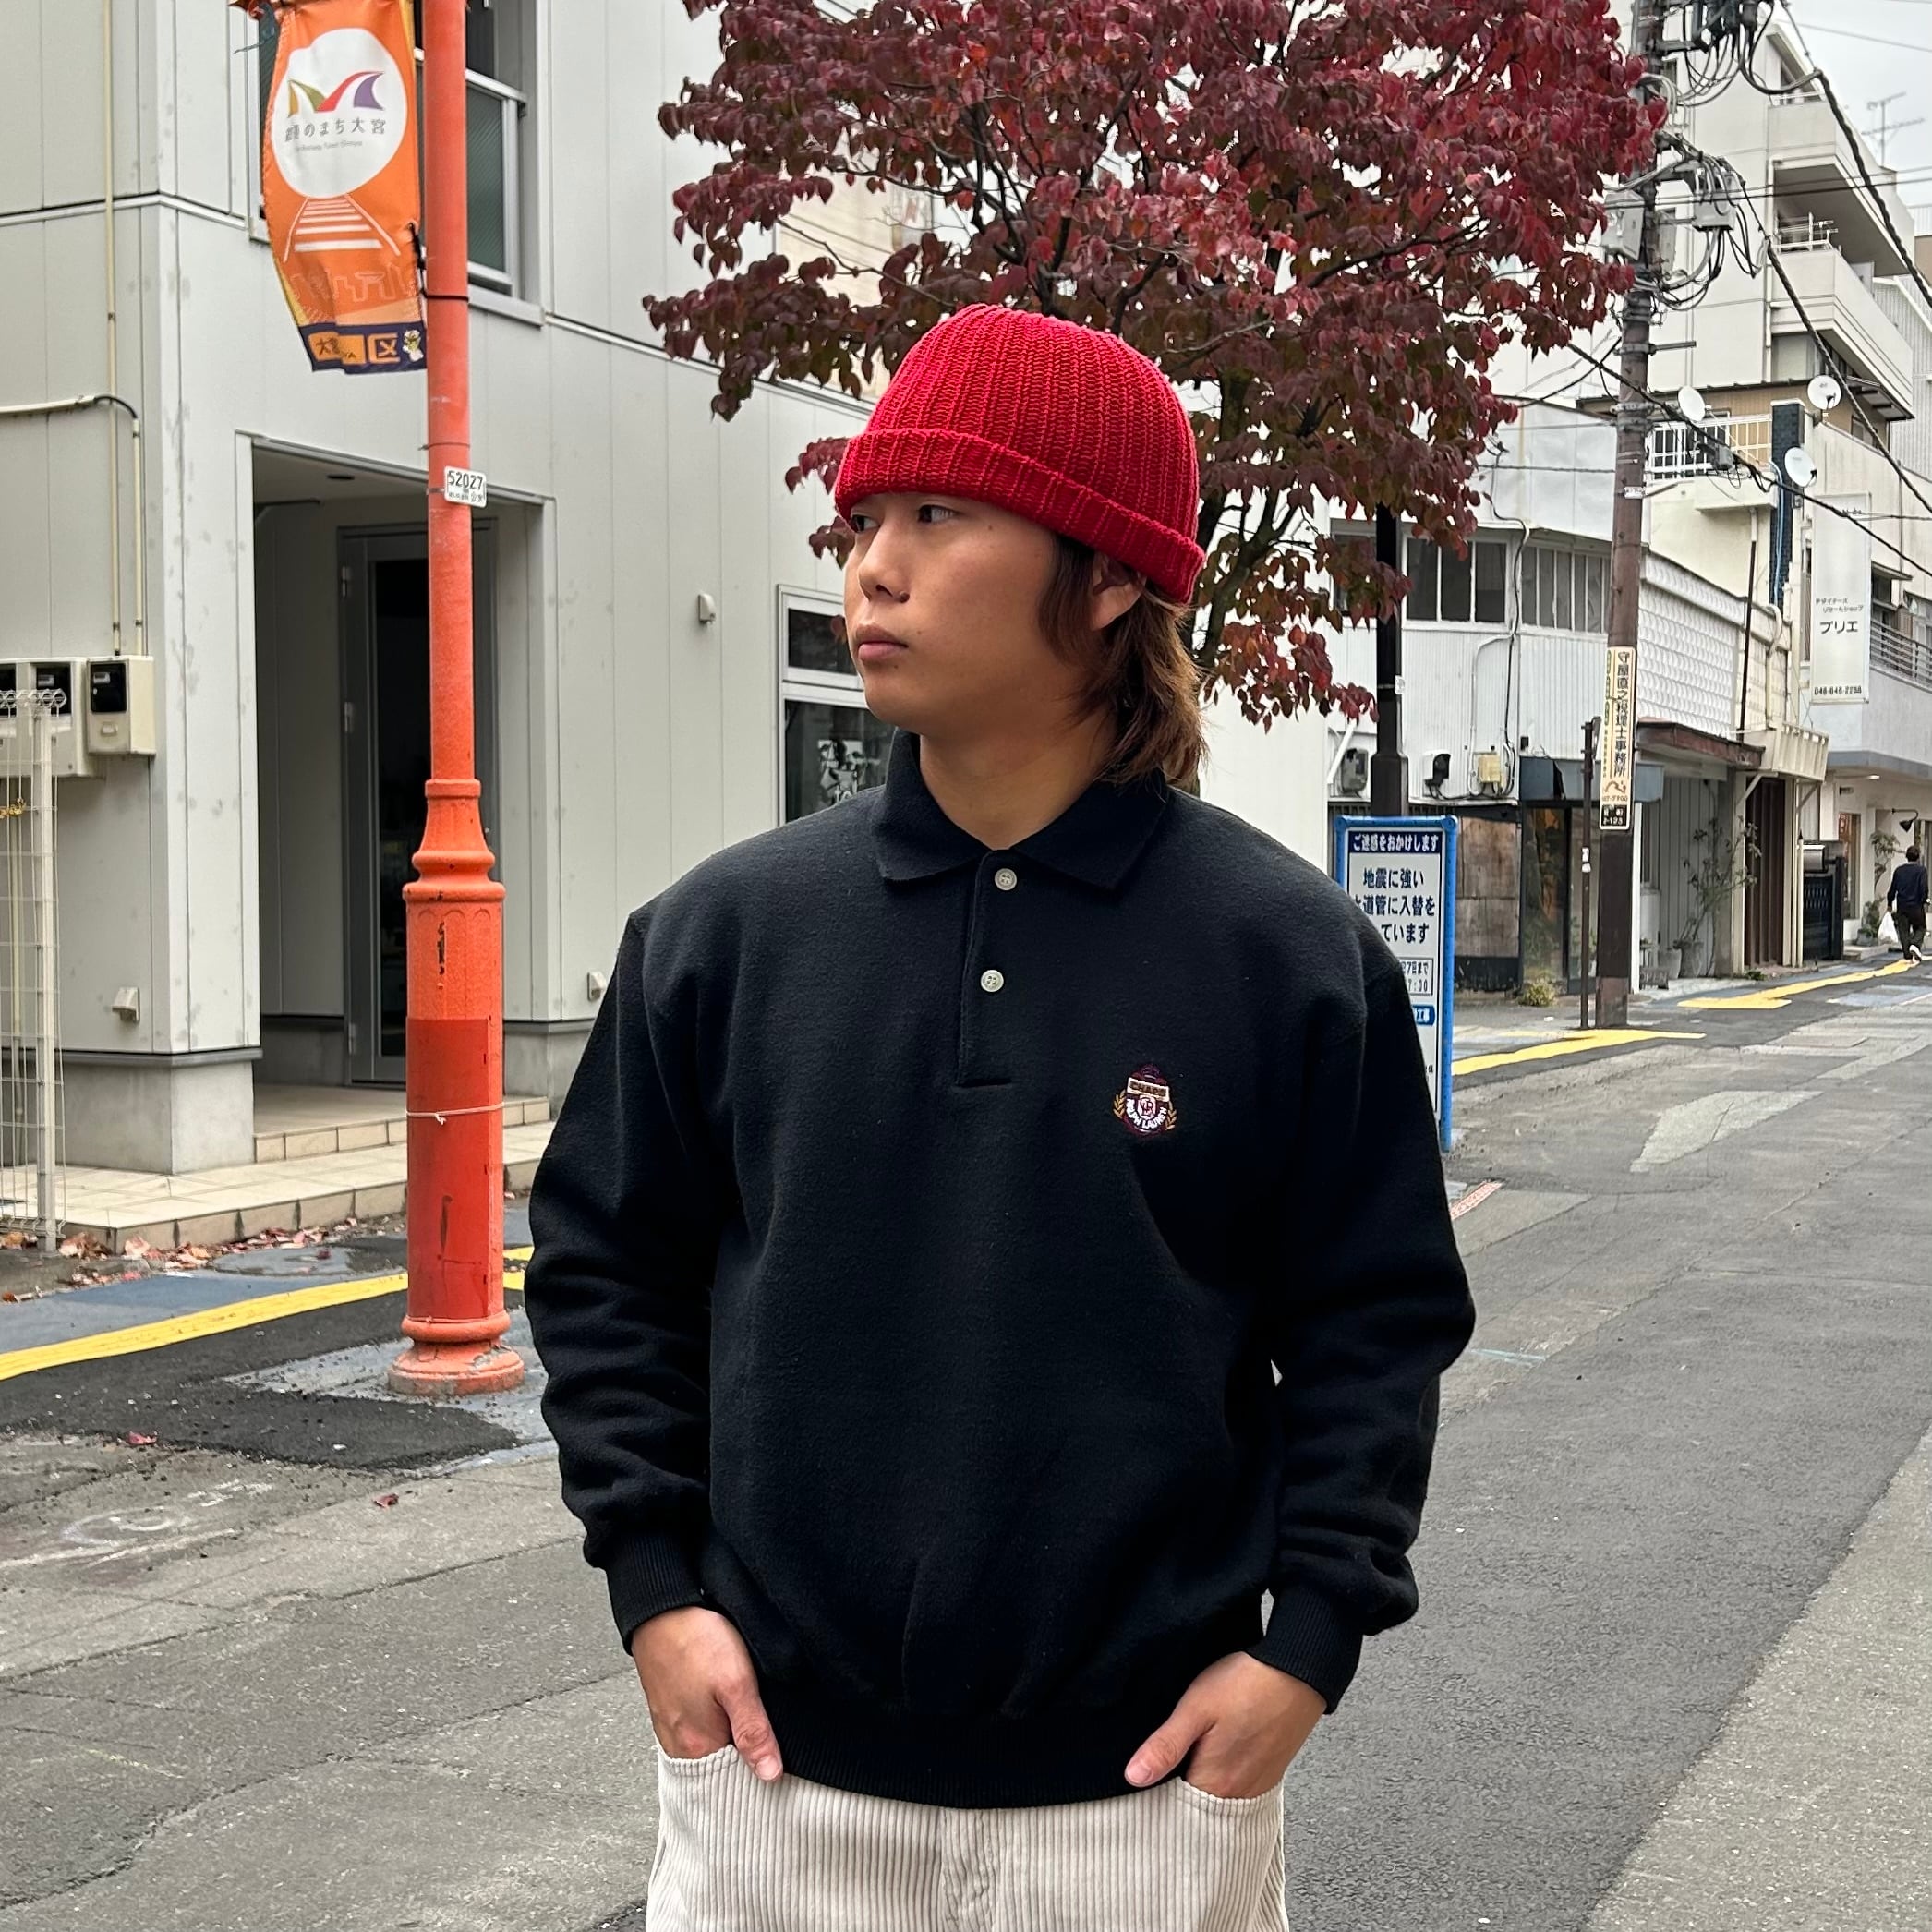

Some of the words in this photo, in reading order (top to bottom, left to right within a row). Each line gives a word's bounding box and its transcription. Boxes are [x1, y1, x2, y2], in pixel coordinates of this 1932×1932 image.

[447, 469, 483, 490] 52027
[1353, 834, 1439, 851] ご迷惑をおかけします
[1362, 867, 1424, 888] 地震に強い
[1381, 923, 1429, 943] ています
